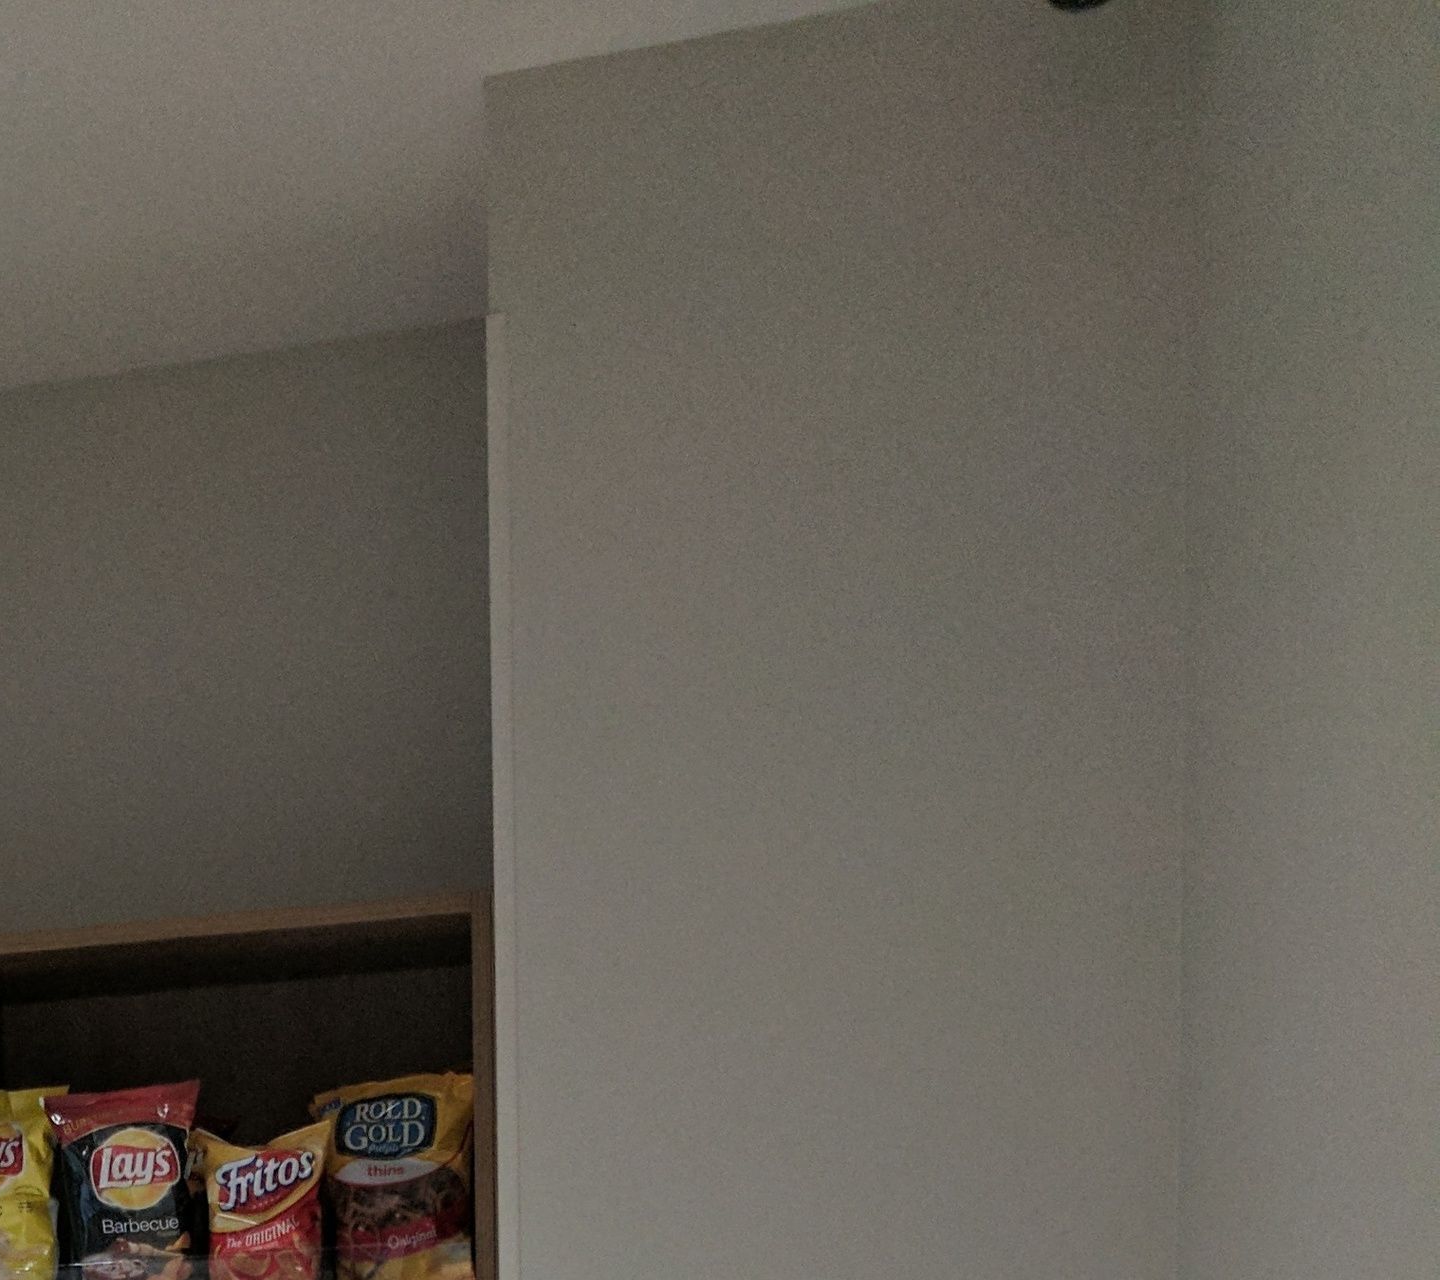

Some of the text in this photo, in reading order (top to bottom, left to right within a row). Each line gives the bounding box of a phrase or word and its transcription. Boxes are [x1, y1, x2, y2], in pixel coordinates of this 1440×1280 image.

[344, 1120, 425, 1152] GOLD
[99, 1145, 172, 1188] Lay's
[216, 1151, 314, 1211] Fritos
[101, 1215, 179, 1235] Barbecue
[245, 1215, 300, 1247] ORIGINAL
